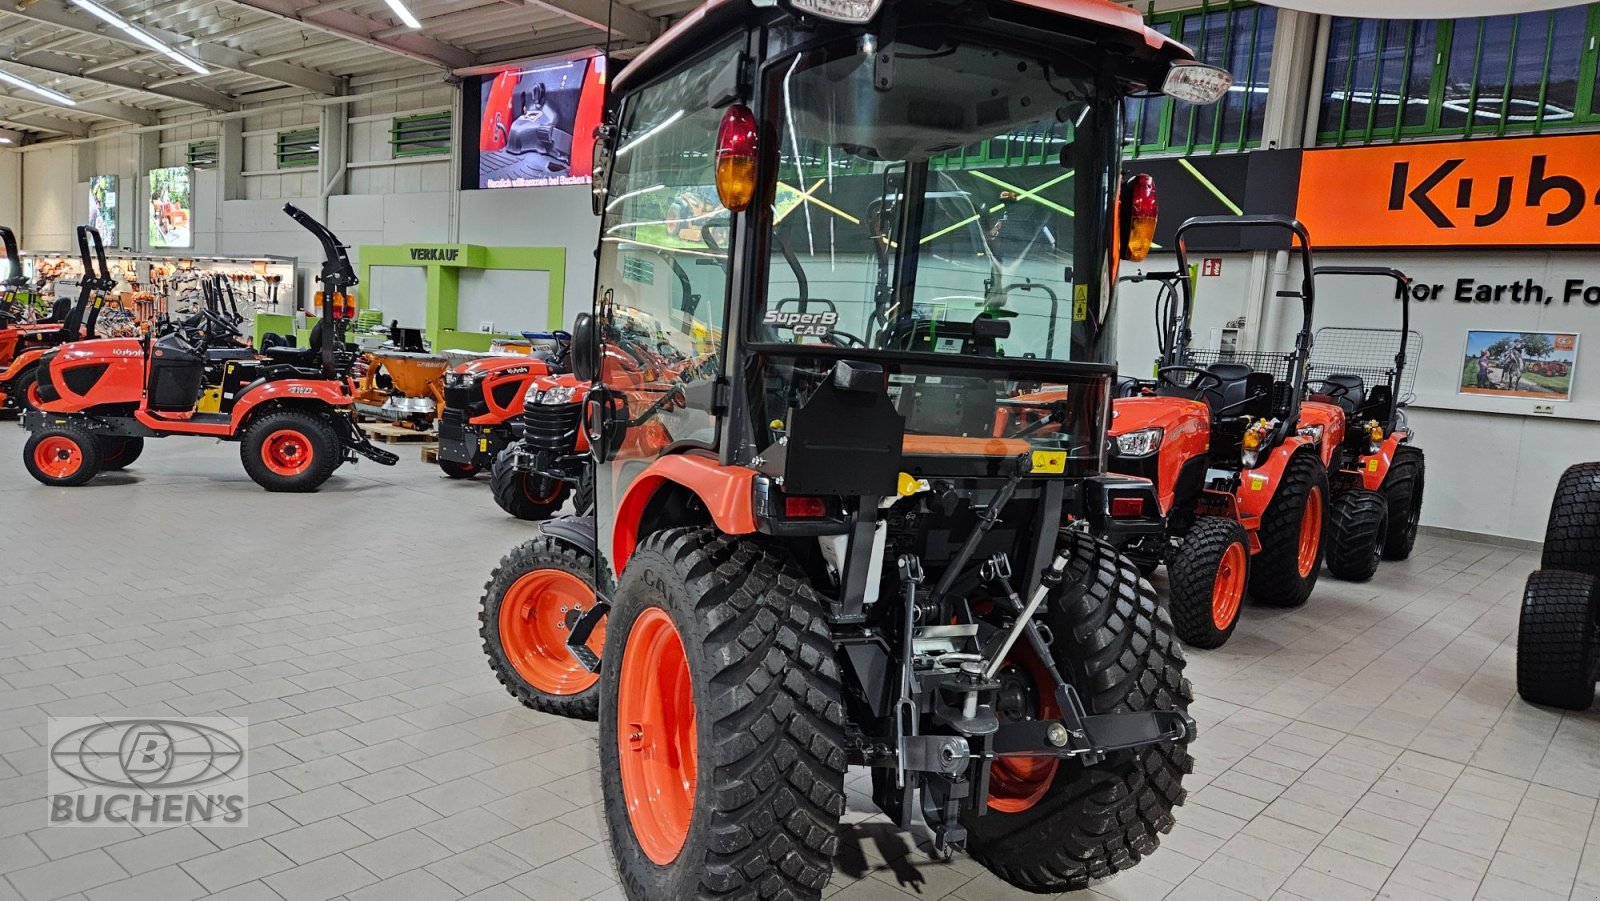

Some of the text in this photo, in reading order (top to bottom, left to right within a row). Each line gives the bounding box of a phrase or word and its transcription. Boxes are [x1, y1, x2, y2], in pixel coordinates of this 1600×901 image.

[487, 178, 513, 188] Herzlich
[512, 176, 548, 188] willkommen
[548, 175, 560, 186] bei
[1388, 155, 1600, 228] Kub
[410, 248, 459, 261] VERKAUF
[1454, 278, 1553, 305] Earth,
[763, 310, 838, 326] SuperB
[793, 325, 828, 336] CAB
